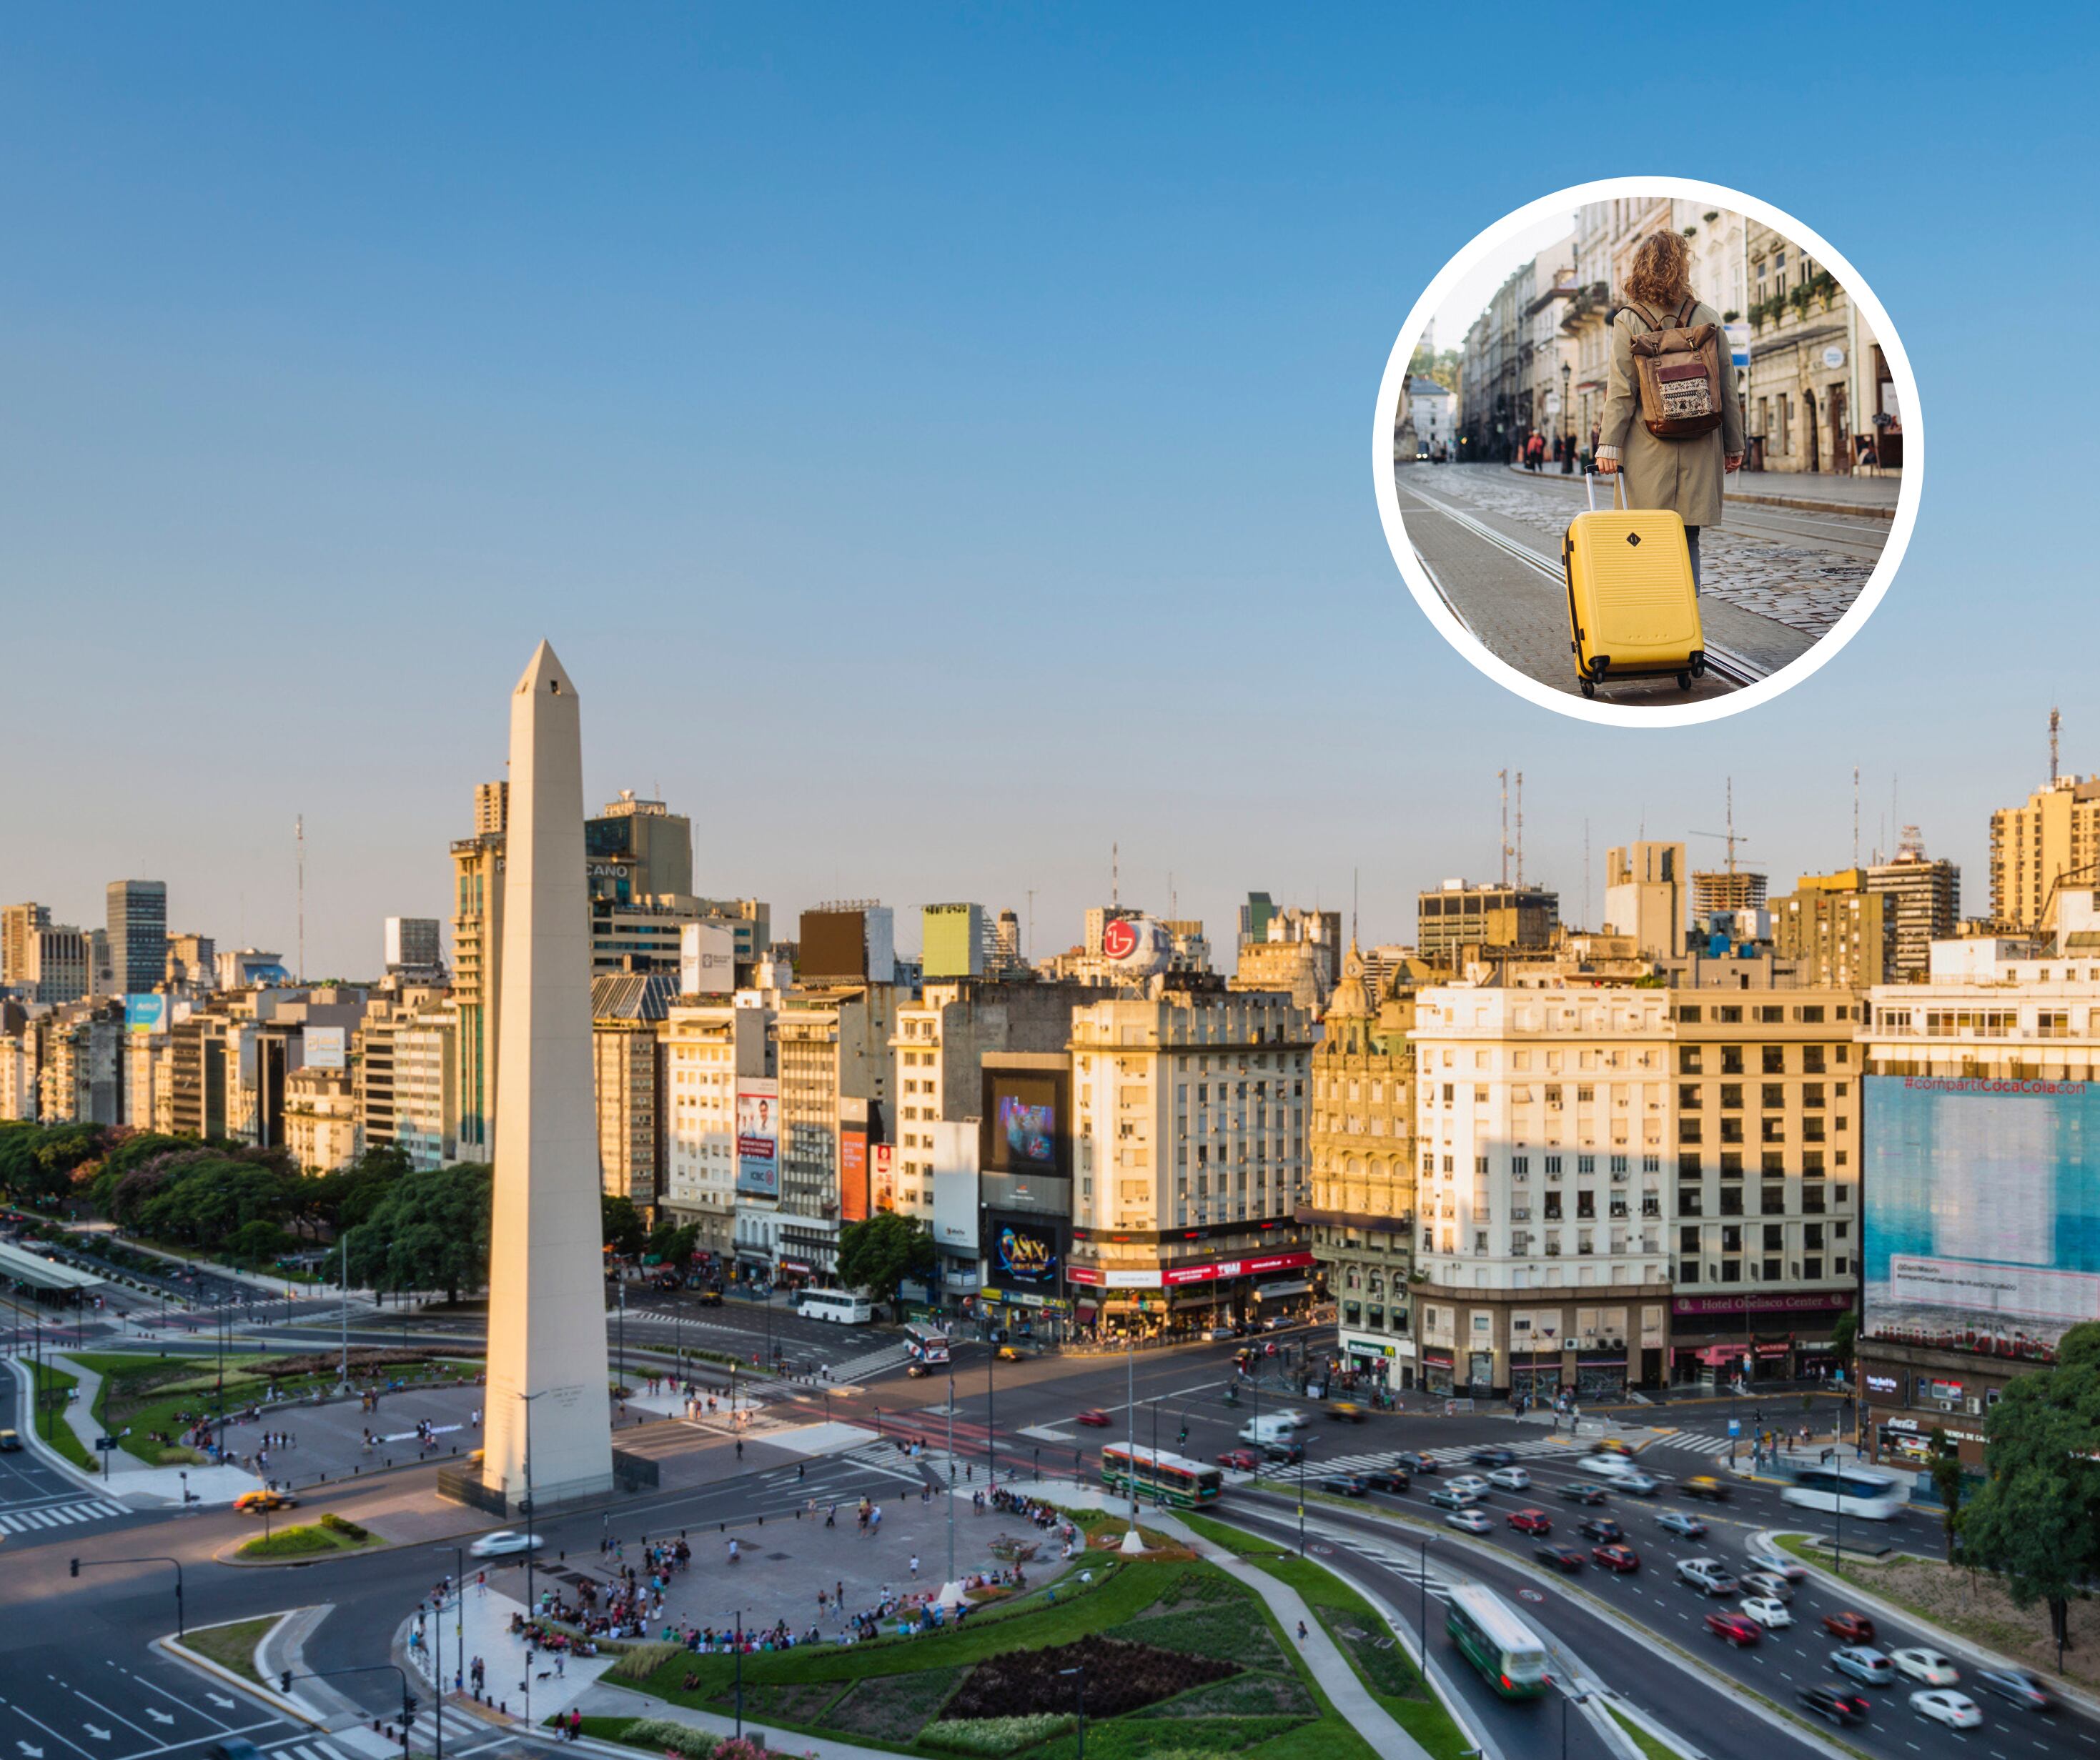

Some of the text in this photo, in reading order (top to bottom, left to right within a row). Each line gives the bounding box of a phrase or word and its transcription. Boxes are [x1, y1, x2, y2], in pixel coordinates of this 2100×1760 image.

[1702, 1297, 1823, 1309] Hotel Obelisco Center
